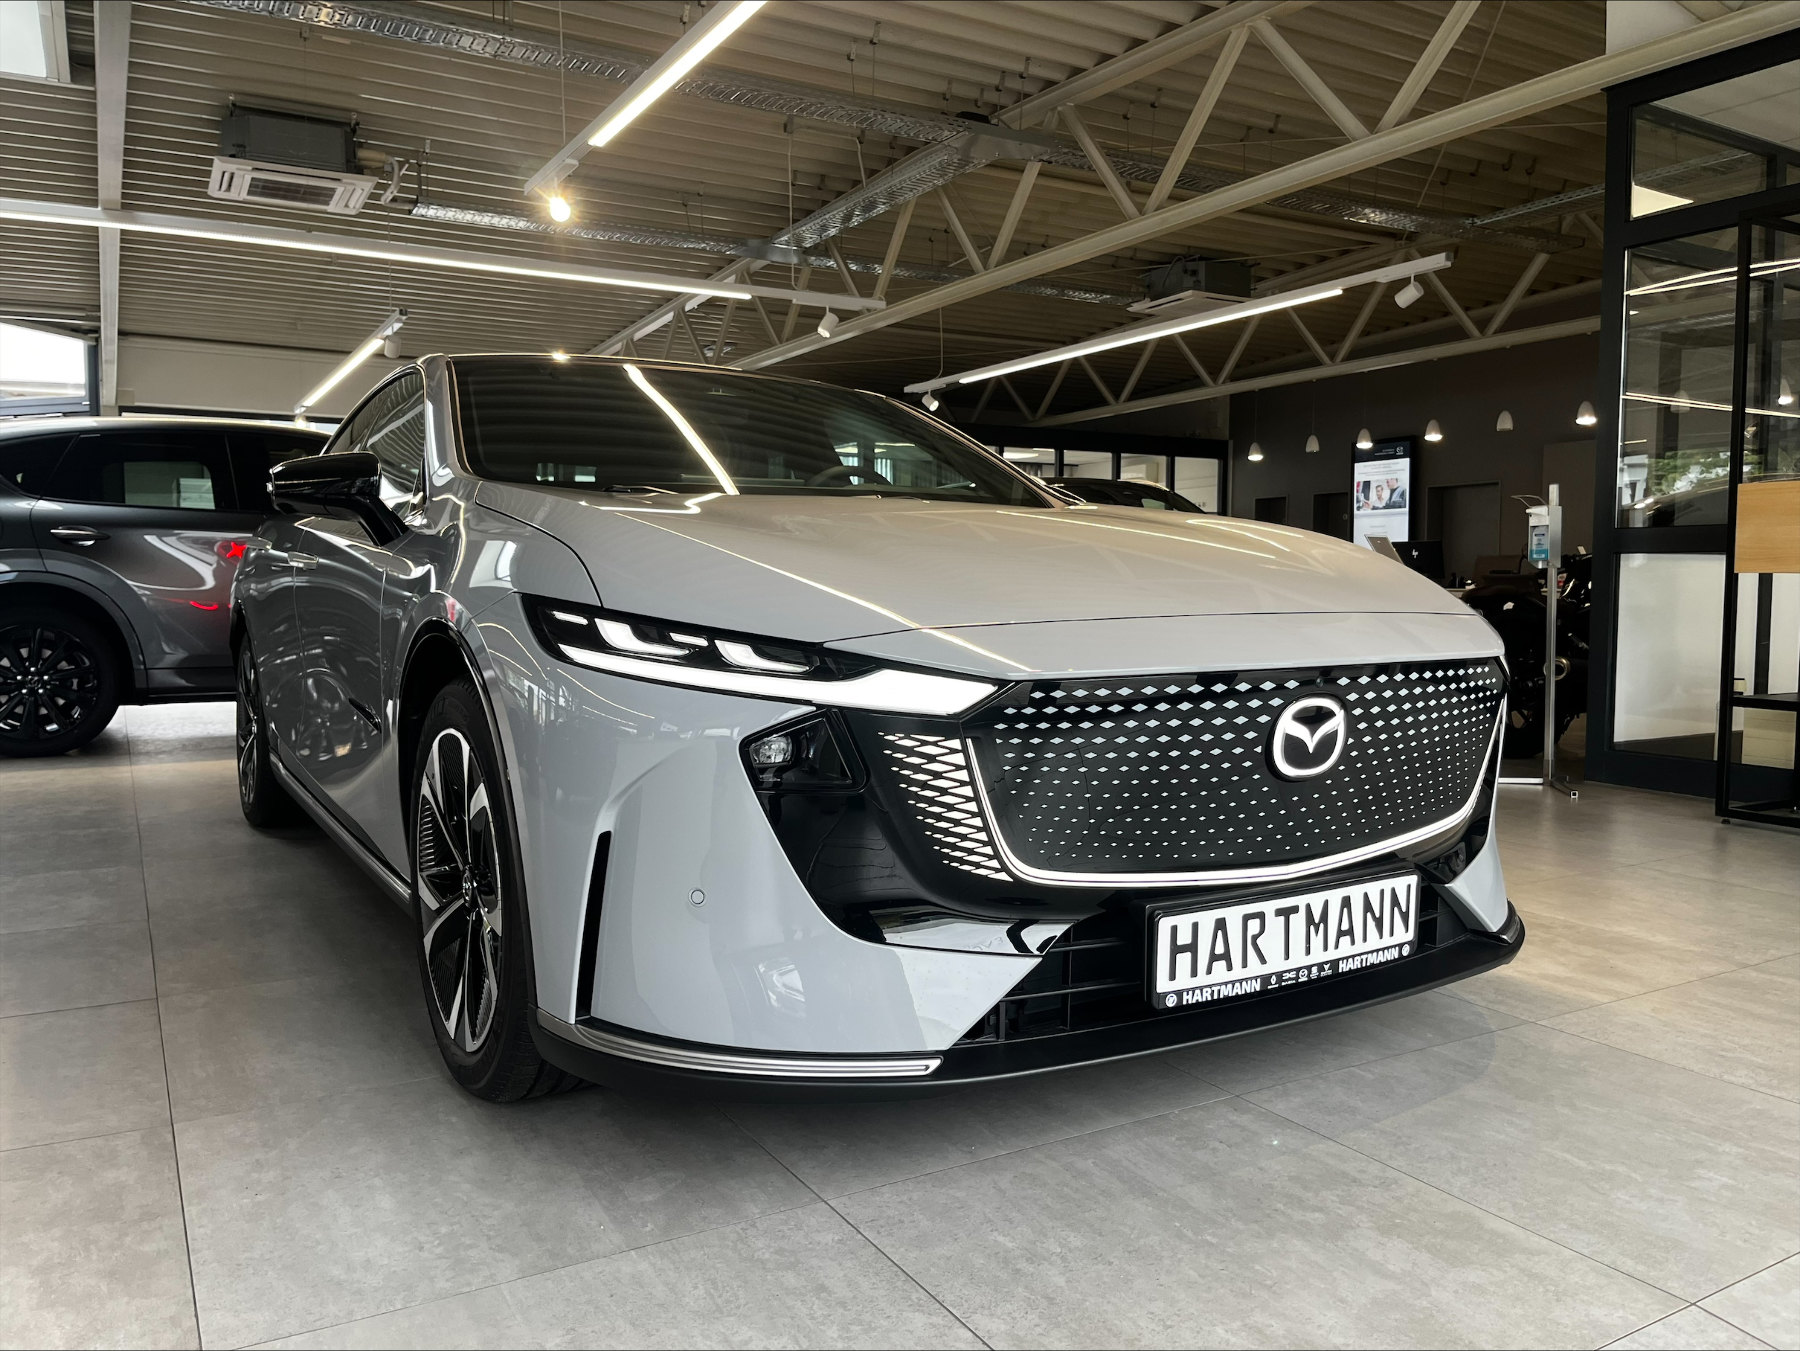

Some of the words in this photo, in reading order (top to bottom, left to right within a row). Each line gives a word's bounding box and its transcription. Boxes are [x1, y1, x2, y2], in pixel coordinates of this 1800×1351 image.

[1168, 883, 1412, 982] HARTMANN
[1182, 978, 1261, 1005] HARTMANN
[1338, 946, 1399, 973] HARTMANN
